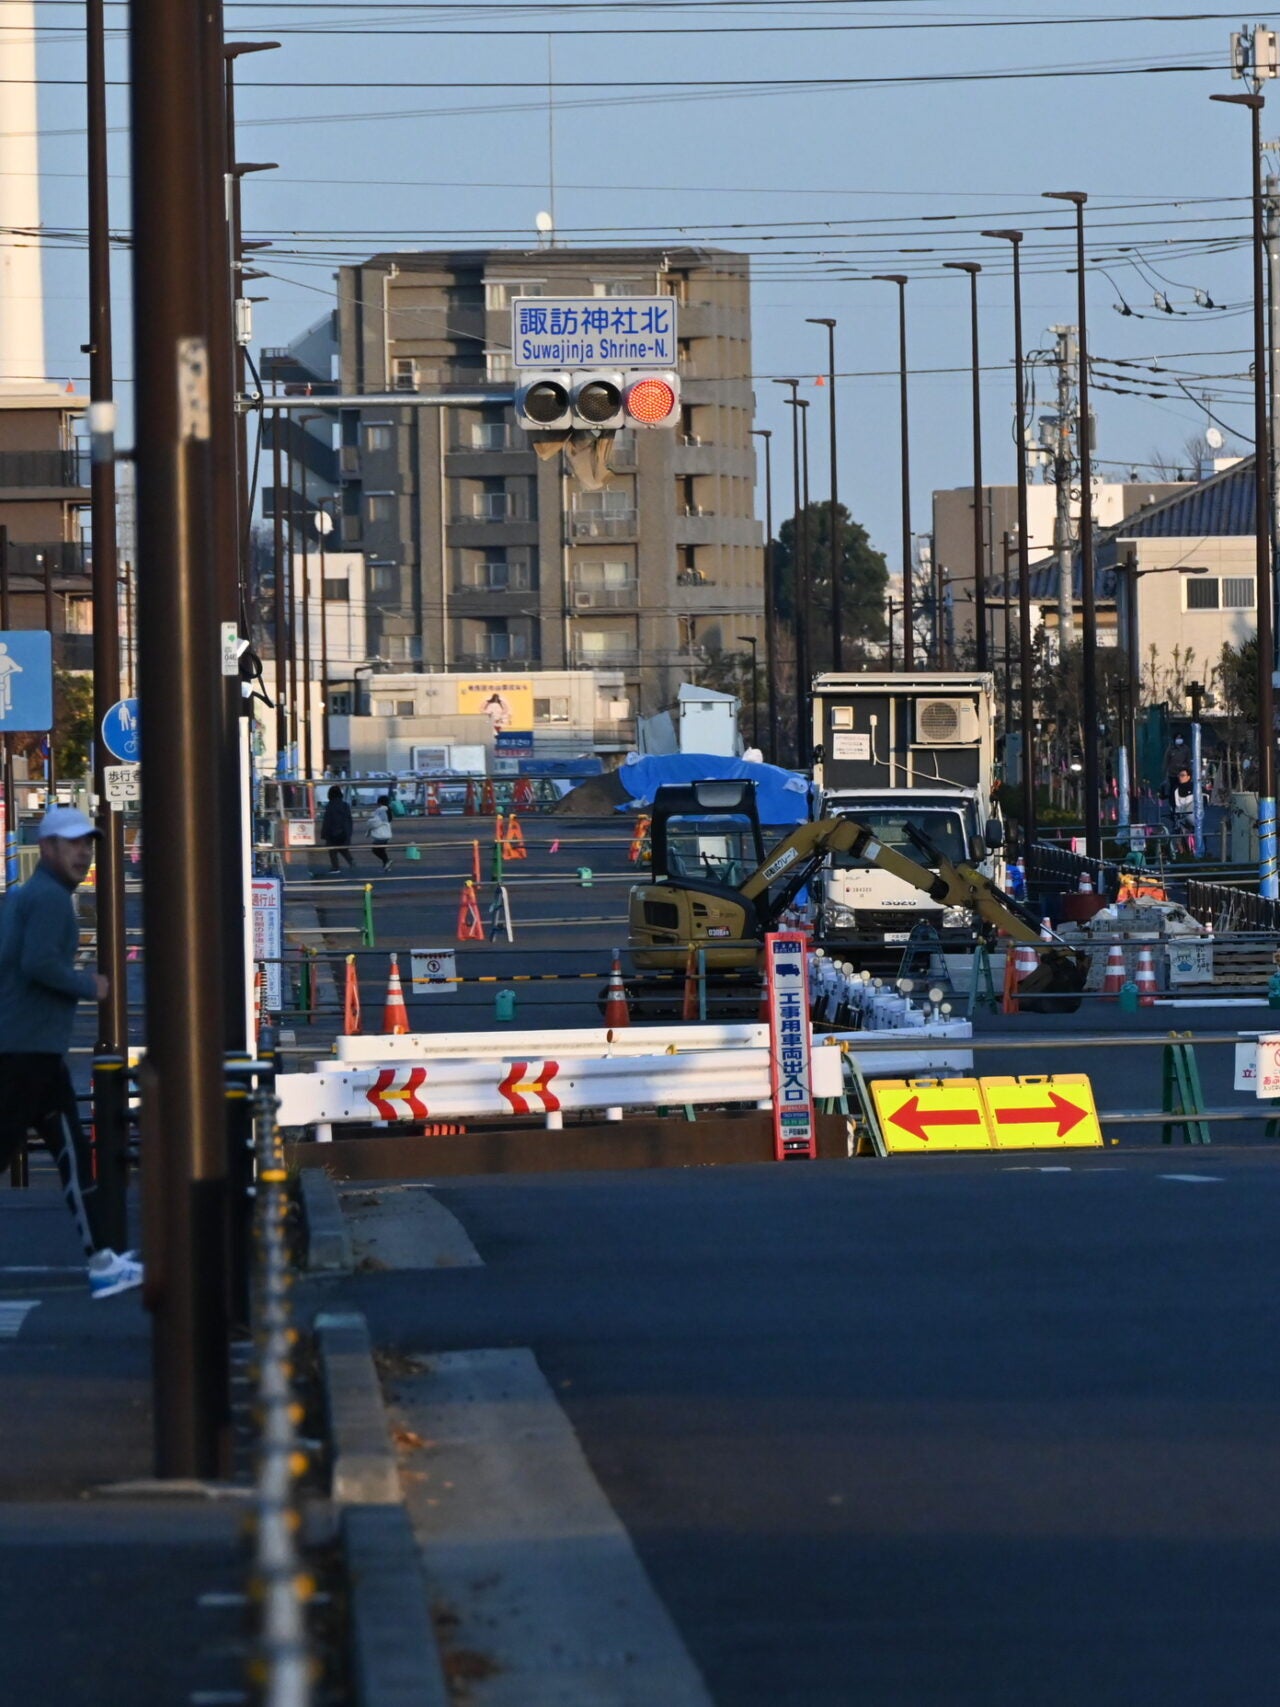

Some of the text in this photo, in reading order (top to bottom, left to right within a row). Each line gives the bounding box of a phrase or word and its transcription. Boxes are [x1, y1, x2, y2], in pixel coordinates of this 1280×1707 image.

[520, 306, 669, 335] 諏訪神社北
[522, 338, 668, 363] Suwajinja Shrine-N.
[779, 992, 803, 1101] 工事用車両出入口
